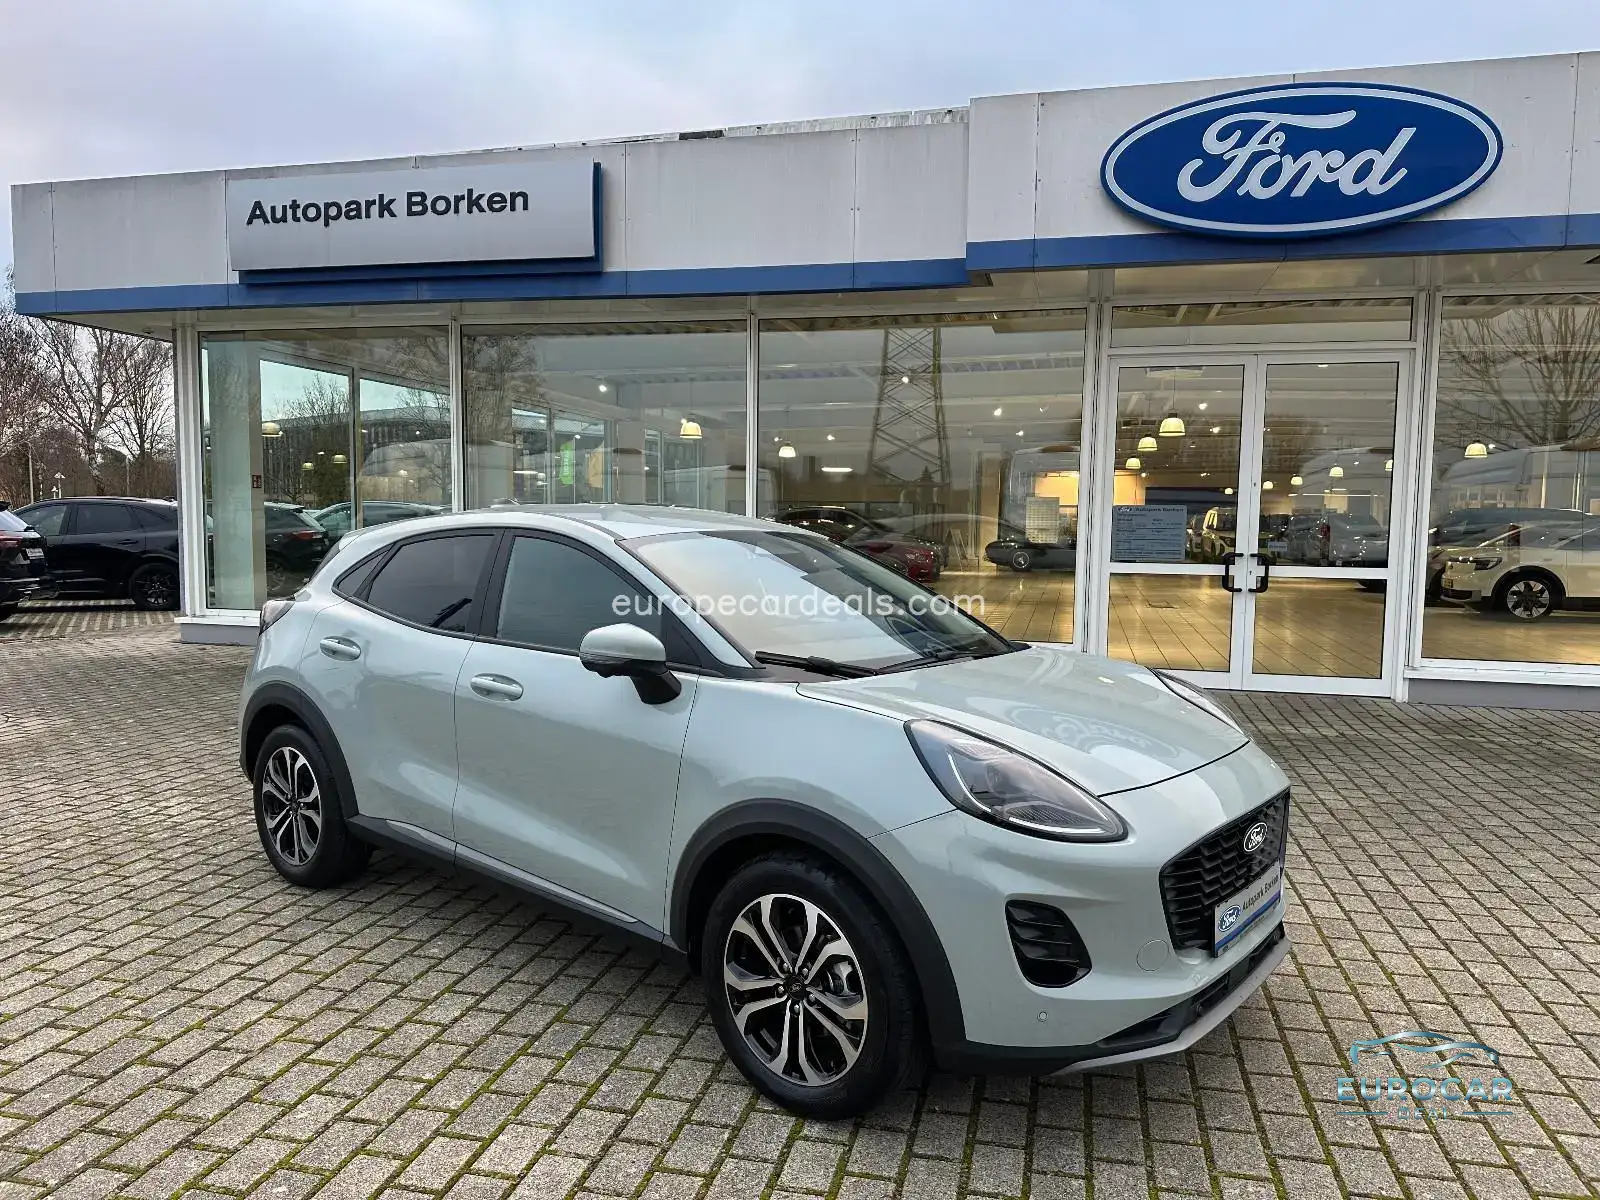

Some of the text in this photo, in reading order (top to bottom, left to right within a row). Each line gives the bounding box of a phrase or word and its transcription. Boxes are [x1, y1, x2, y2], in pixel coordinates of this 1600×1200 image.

[1177, 109, 1417, 203] Ford
[246, 188, 529, 228] Autopark Borken
